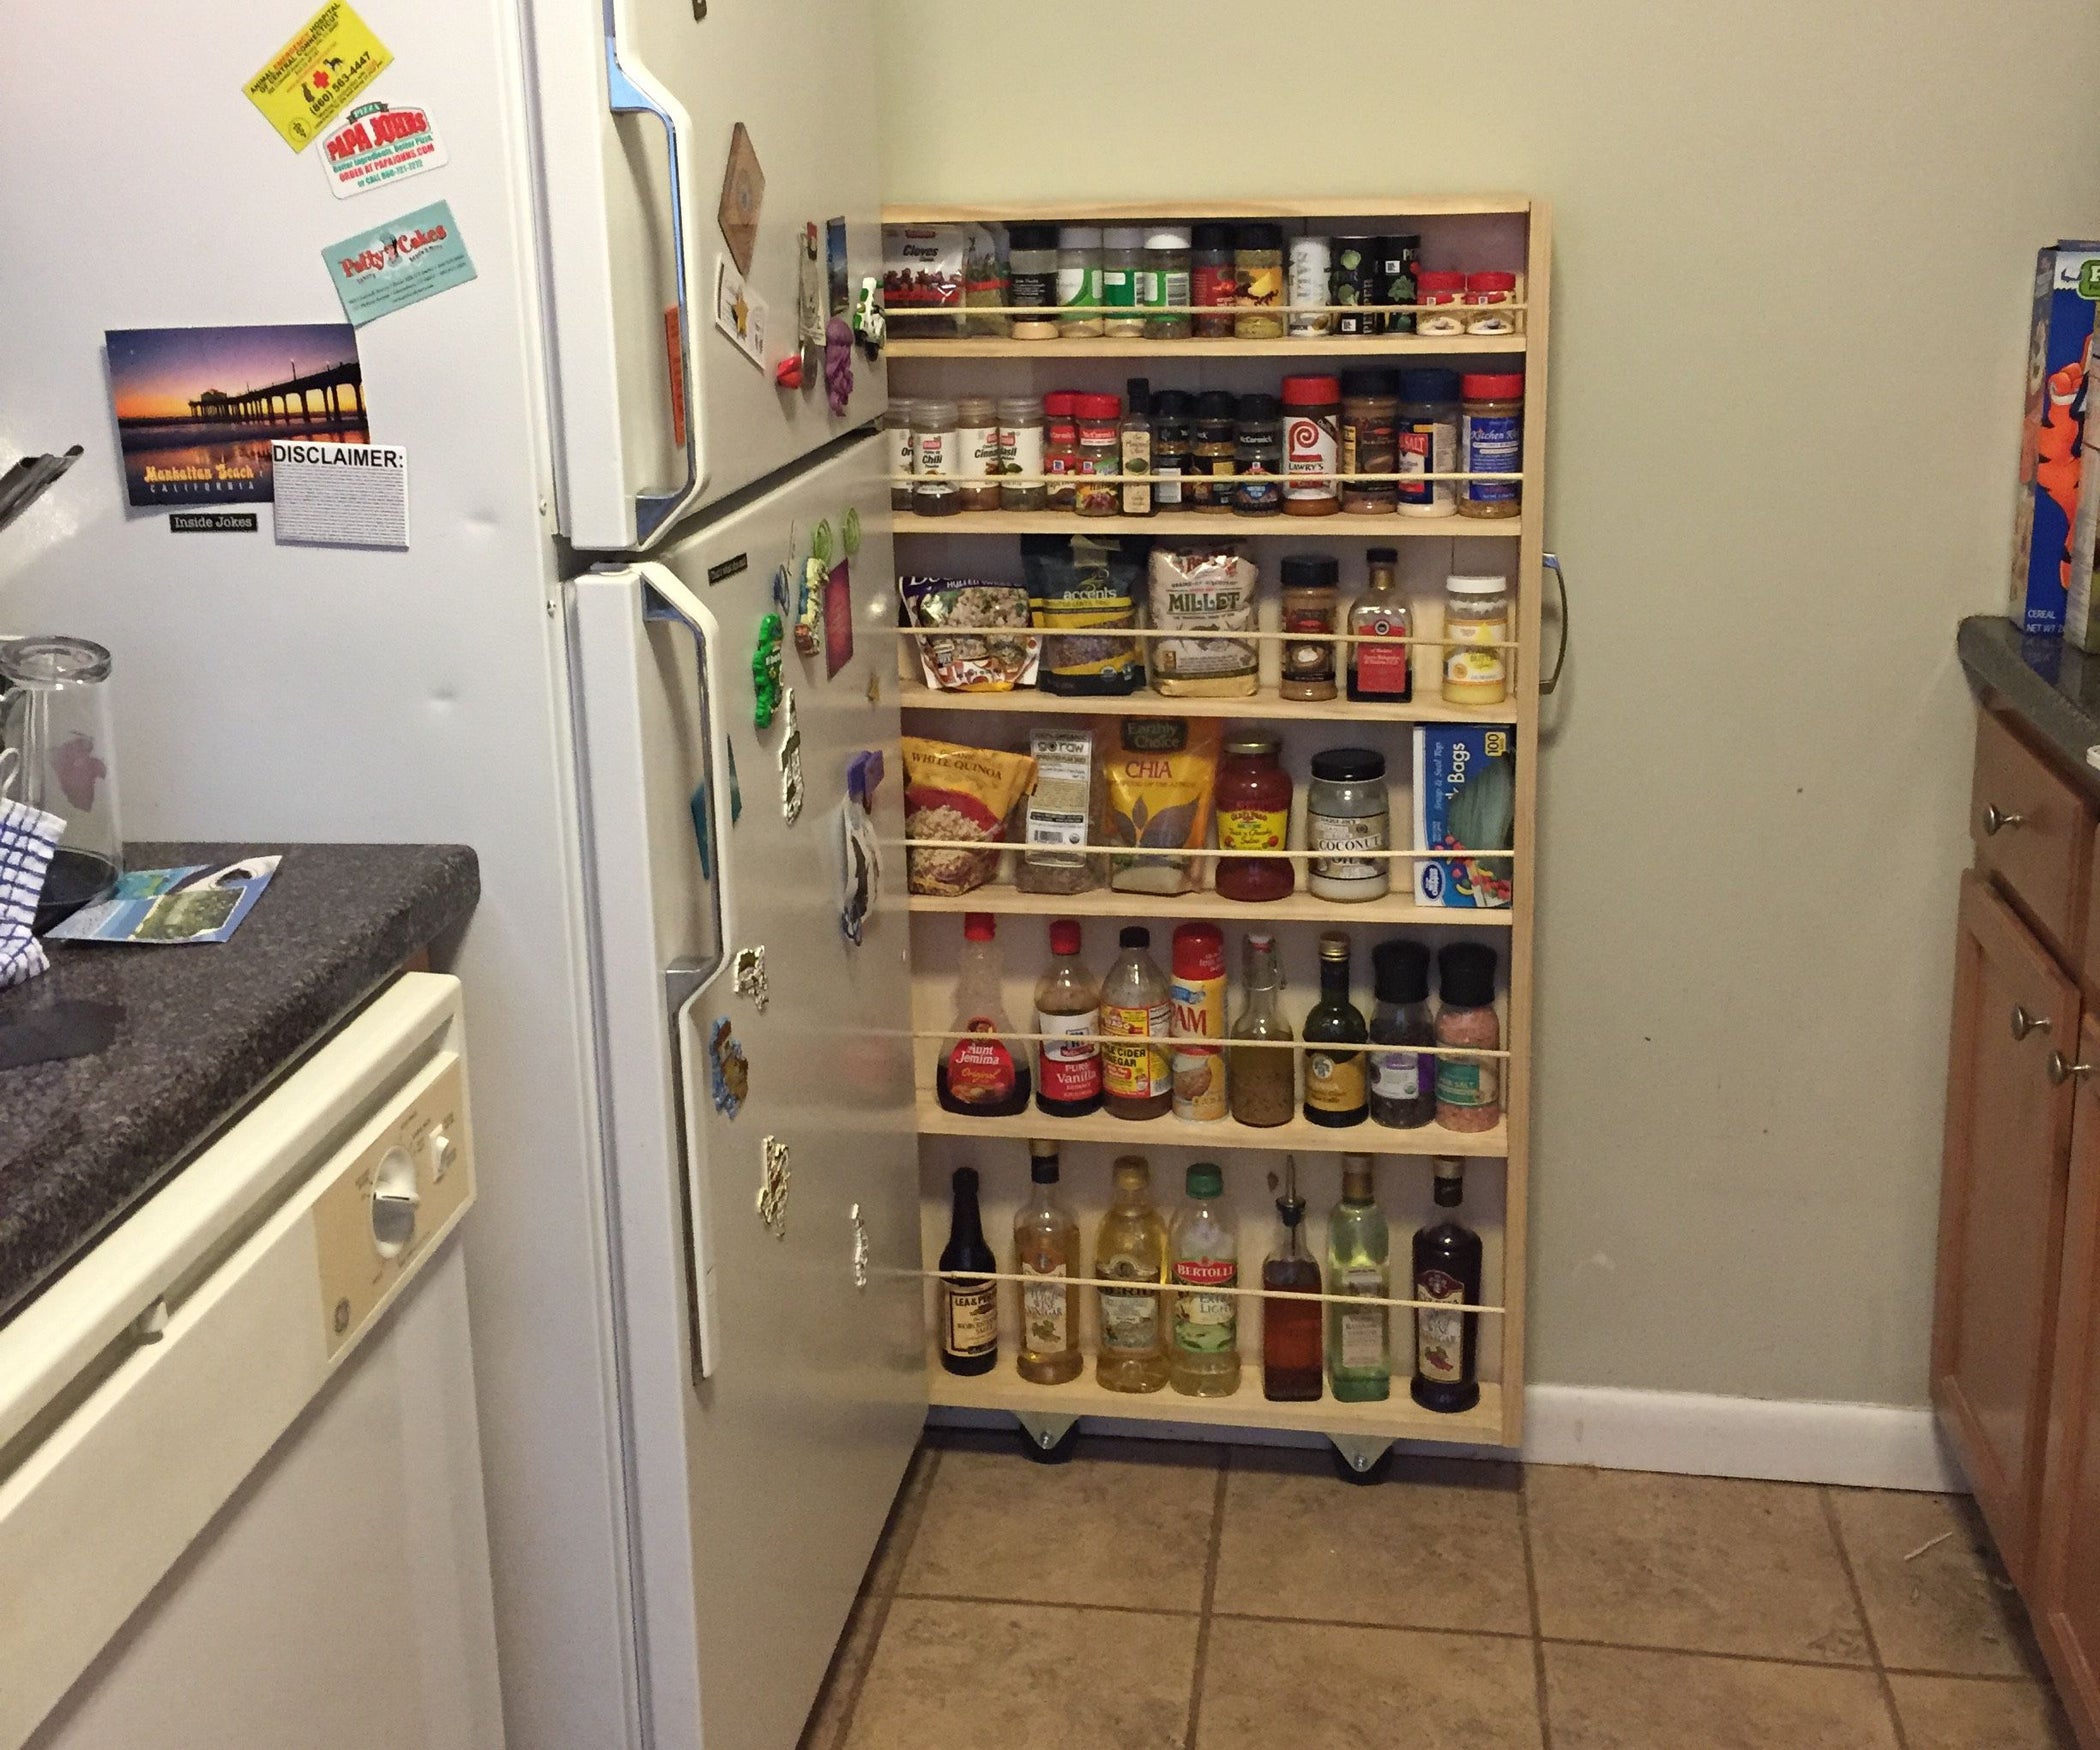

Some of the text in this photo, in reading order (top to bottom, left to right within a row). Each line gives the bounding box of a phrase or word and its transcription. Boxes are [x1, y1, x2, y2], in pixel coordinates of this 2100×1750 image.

[327, 123, 373, 161] PAPA
[273, 444, 404, 468] DISCLAIMER:
[144, 462, 254, 483] Manhattan Beach
[1289, 463, 1323, 471] LAWRY'S
[149, 481, 255, 494] CALIFORNIA
[173, 515, 253, 528] Inside Jokes
[1063, 587, 1117, 600] accents
[1168, 592, 1240, 612] MILLET
[1127, 722, 1177, 738] Earthly
[1134, 735, 1180, 748] Choice
[1487, 733, 1499, 755] 100
[911, 752, 1002, 780] WHITE QUINOA
[1125, 761, 1172, 778] CHIA
[1447, 743, 1470, 783] Bags
[1319, 836, 1378, 851] COCONUT
[966, 1043, 994, 1055] Aunt
[1117, 1047, 1146, 1057] CIDER
[955, 1052, 1000, 1065] Jemima
[1057, 1070, 1096, 1083] Vanilla
[1177, 1264, 1233, 1277] BERTOLLI
[955, 1298, 970, 1306] LEA
